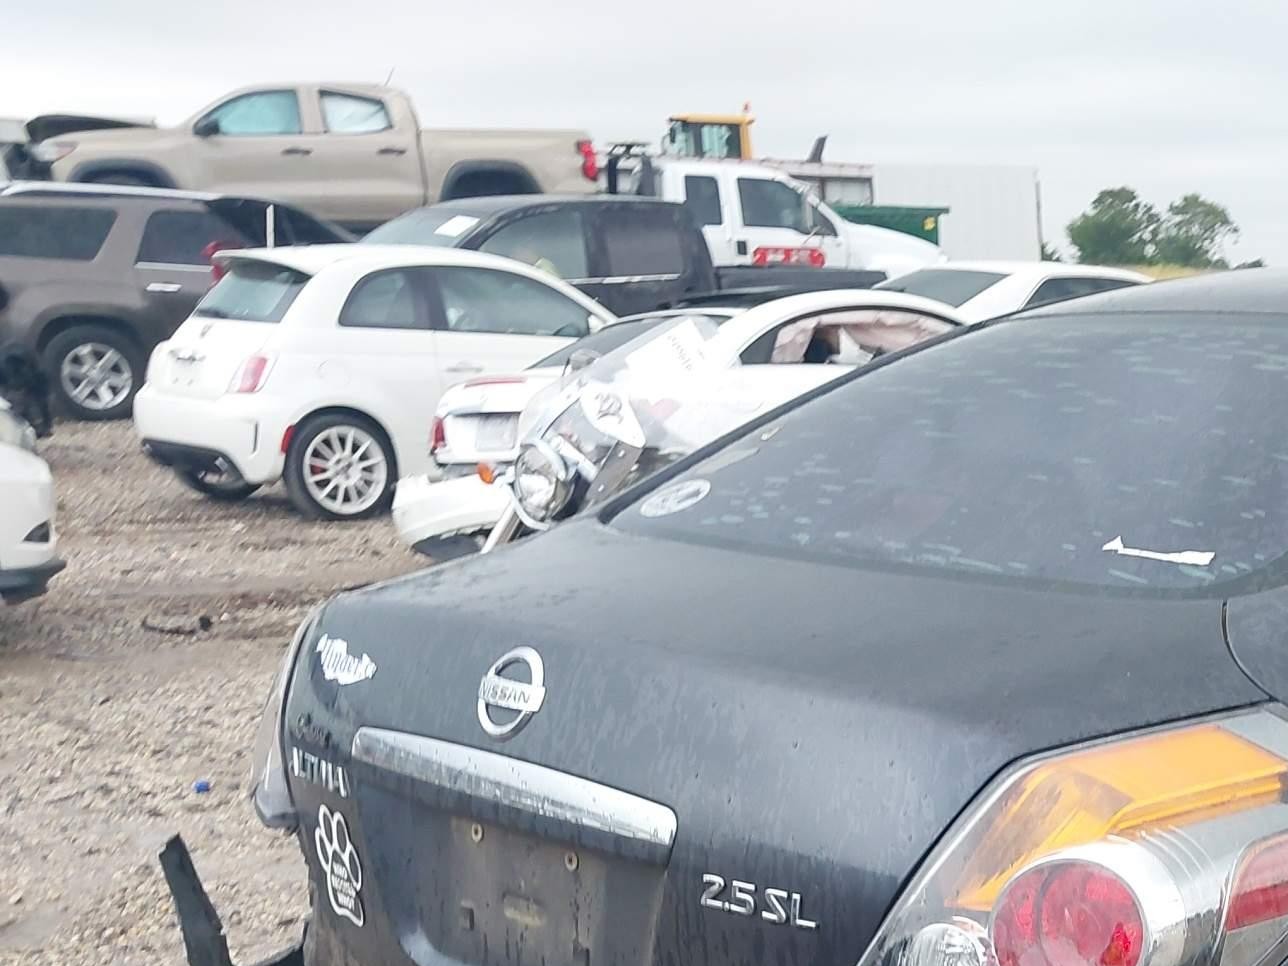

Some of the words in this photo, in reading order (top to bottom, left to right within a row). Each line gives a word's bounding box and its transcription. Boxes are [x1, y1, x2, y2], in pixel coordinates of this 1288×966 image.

[479, 677, 531, 704] NISSAN
[700, 873, 756, 916] 2.5
[761, 887, 817, 928] SL
